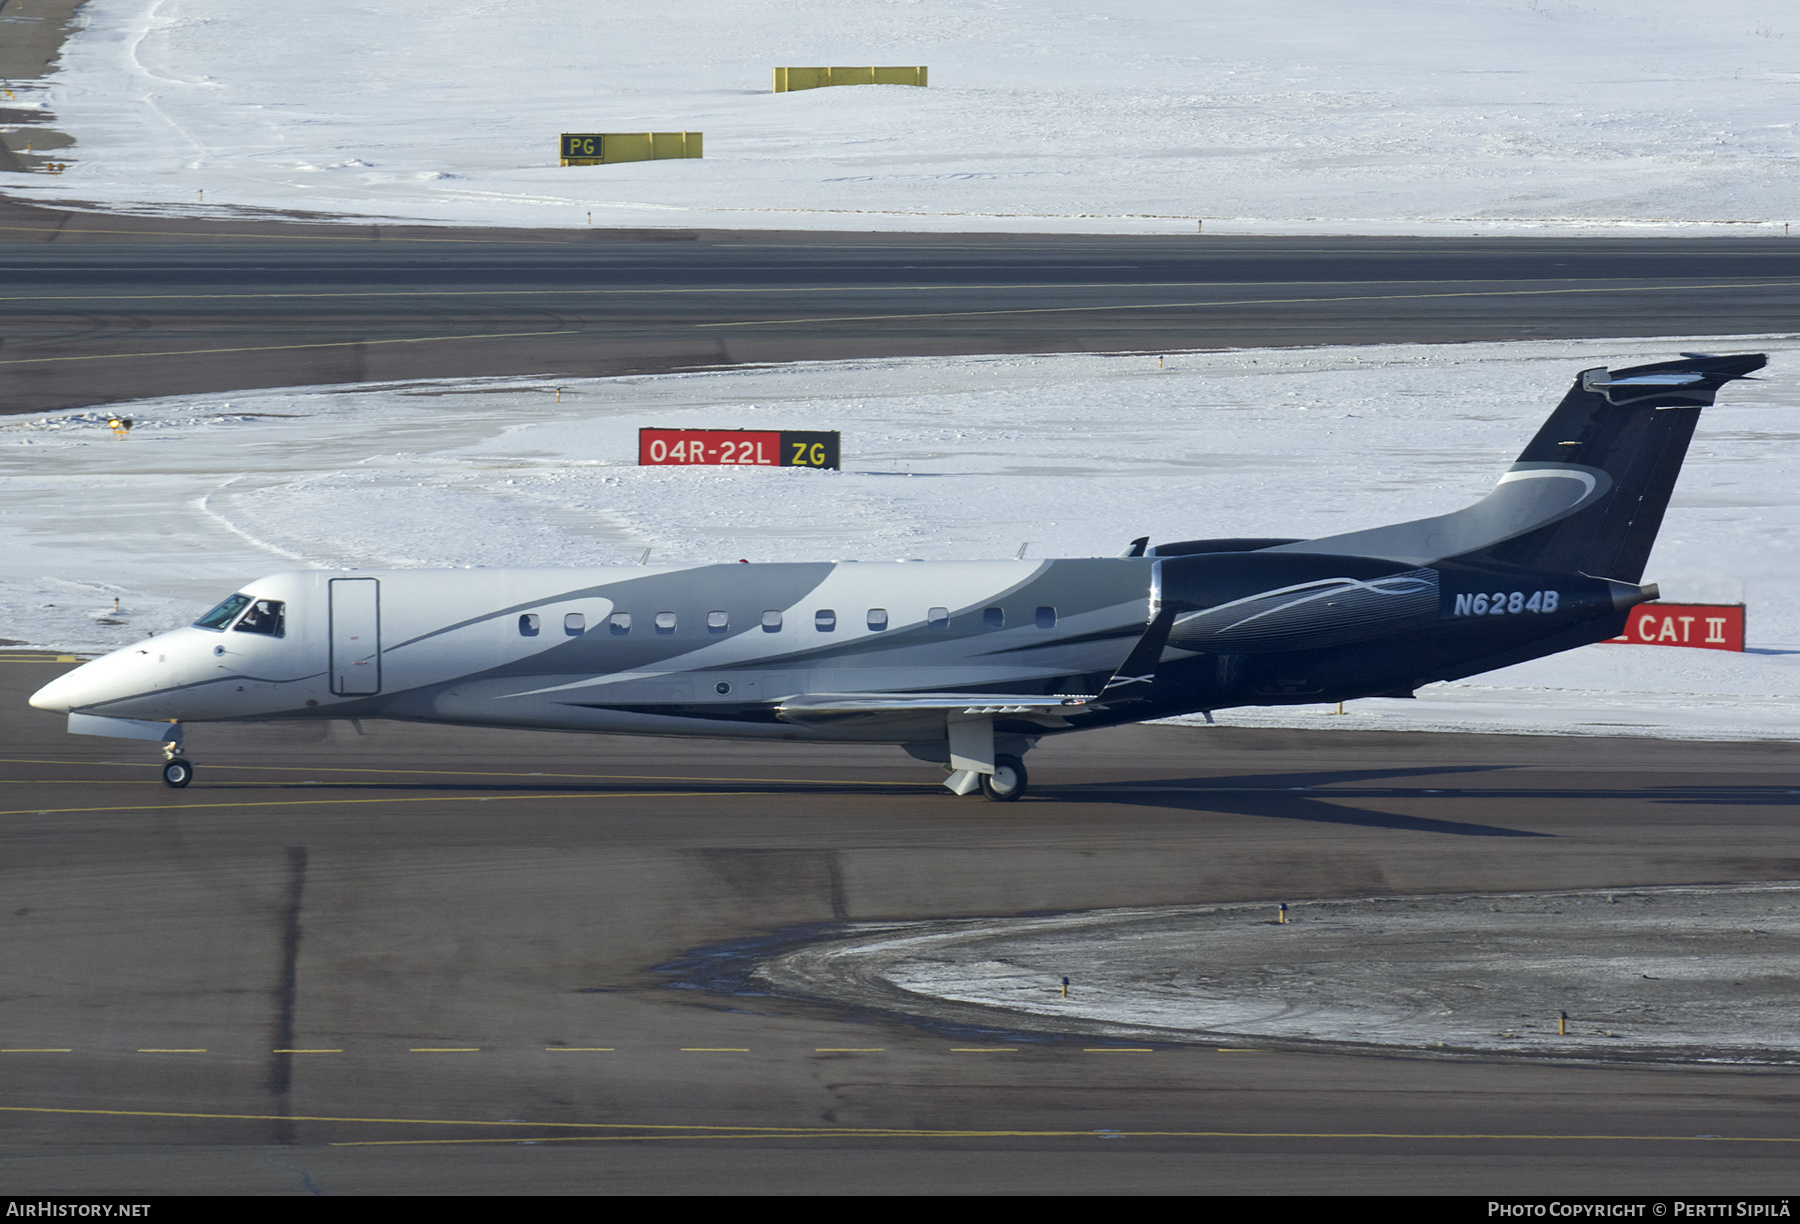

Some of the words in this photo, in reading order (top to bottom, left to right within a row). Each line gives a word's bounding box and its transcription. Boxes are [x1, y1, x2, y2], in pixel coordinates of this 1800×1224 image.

[570, 138, 595, 155] PG
[650, 439, 771, 464] 04R-22L
[791, 442, 826, 466] ZG
[1454, 590, 1560, 616] N6284B
[1638, 615, 1695, 642] CAT
[1704, 617, 1726, 643] II
